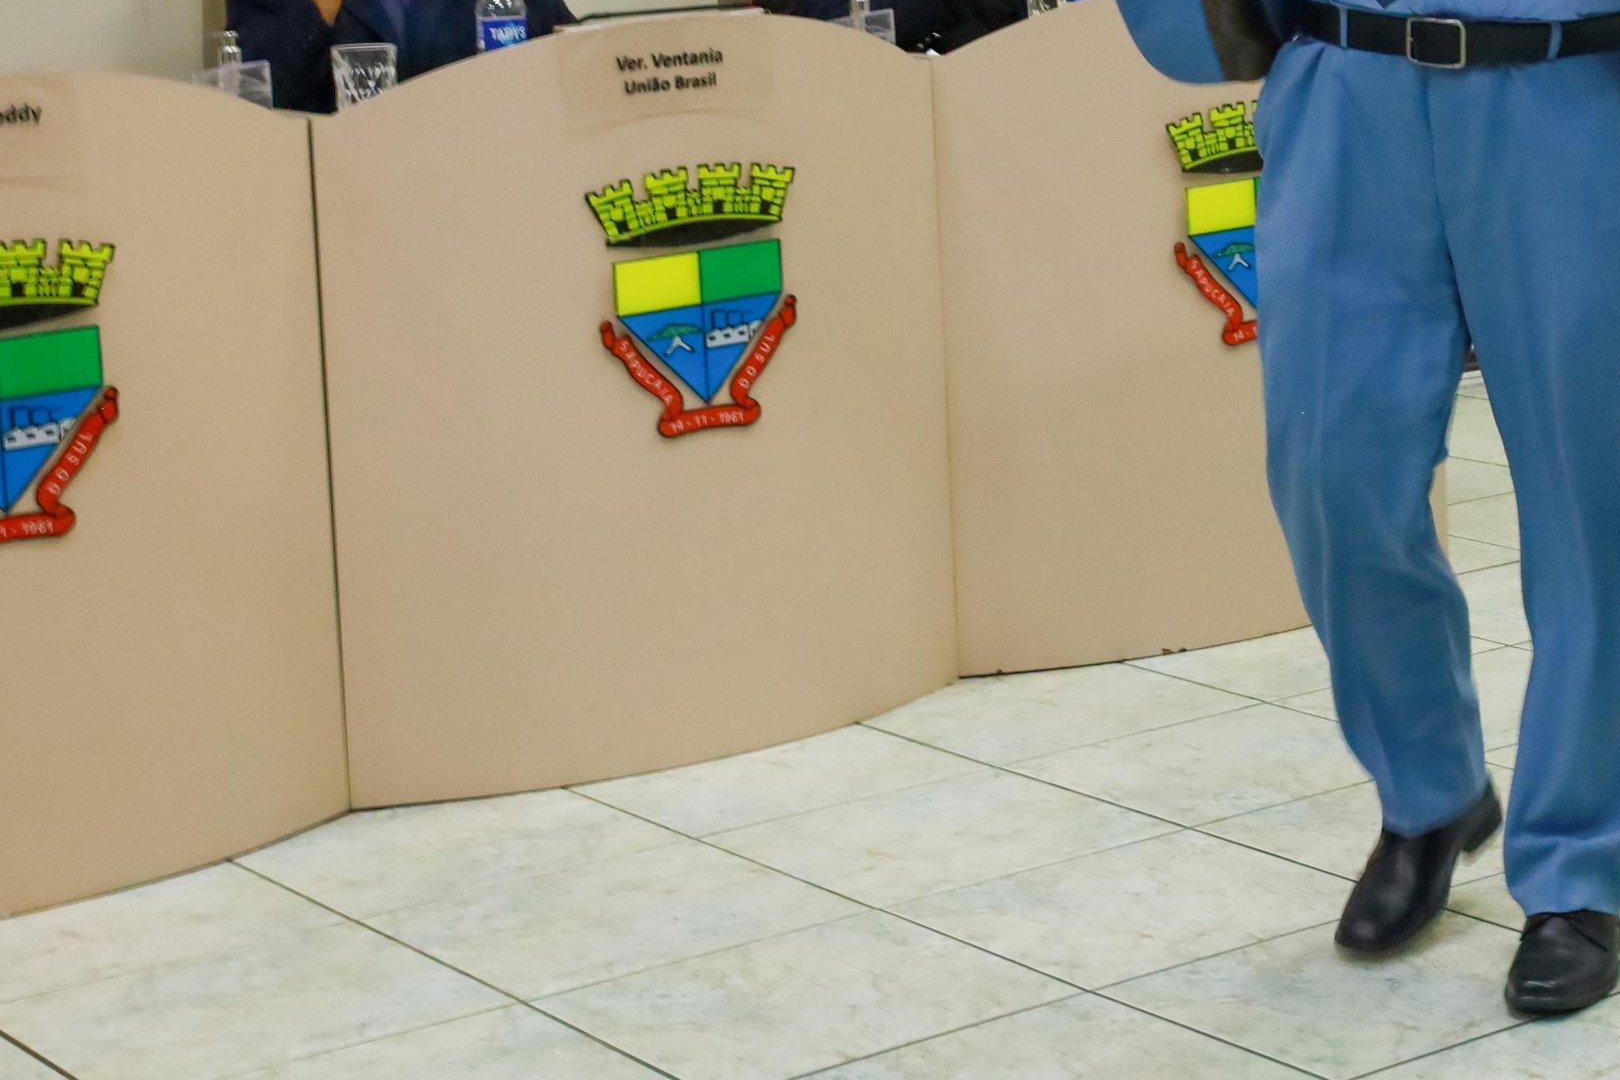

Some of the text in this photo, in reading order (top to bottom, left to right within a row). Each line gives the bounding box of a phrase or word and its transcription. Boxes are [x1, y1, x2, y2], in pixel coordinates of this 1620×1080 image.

[615, 47, 723, 72] Ver. Ventania
[624, 71, 717, 95] União Brasil
[619, 340, 674, 406] SAPUCAIA
